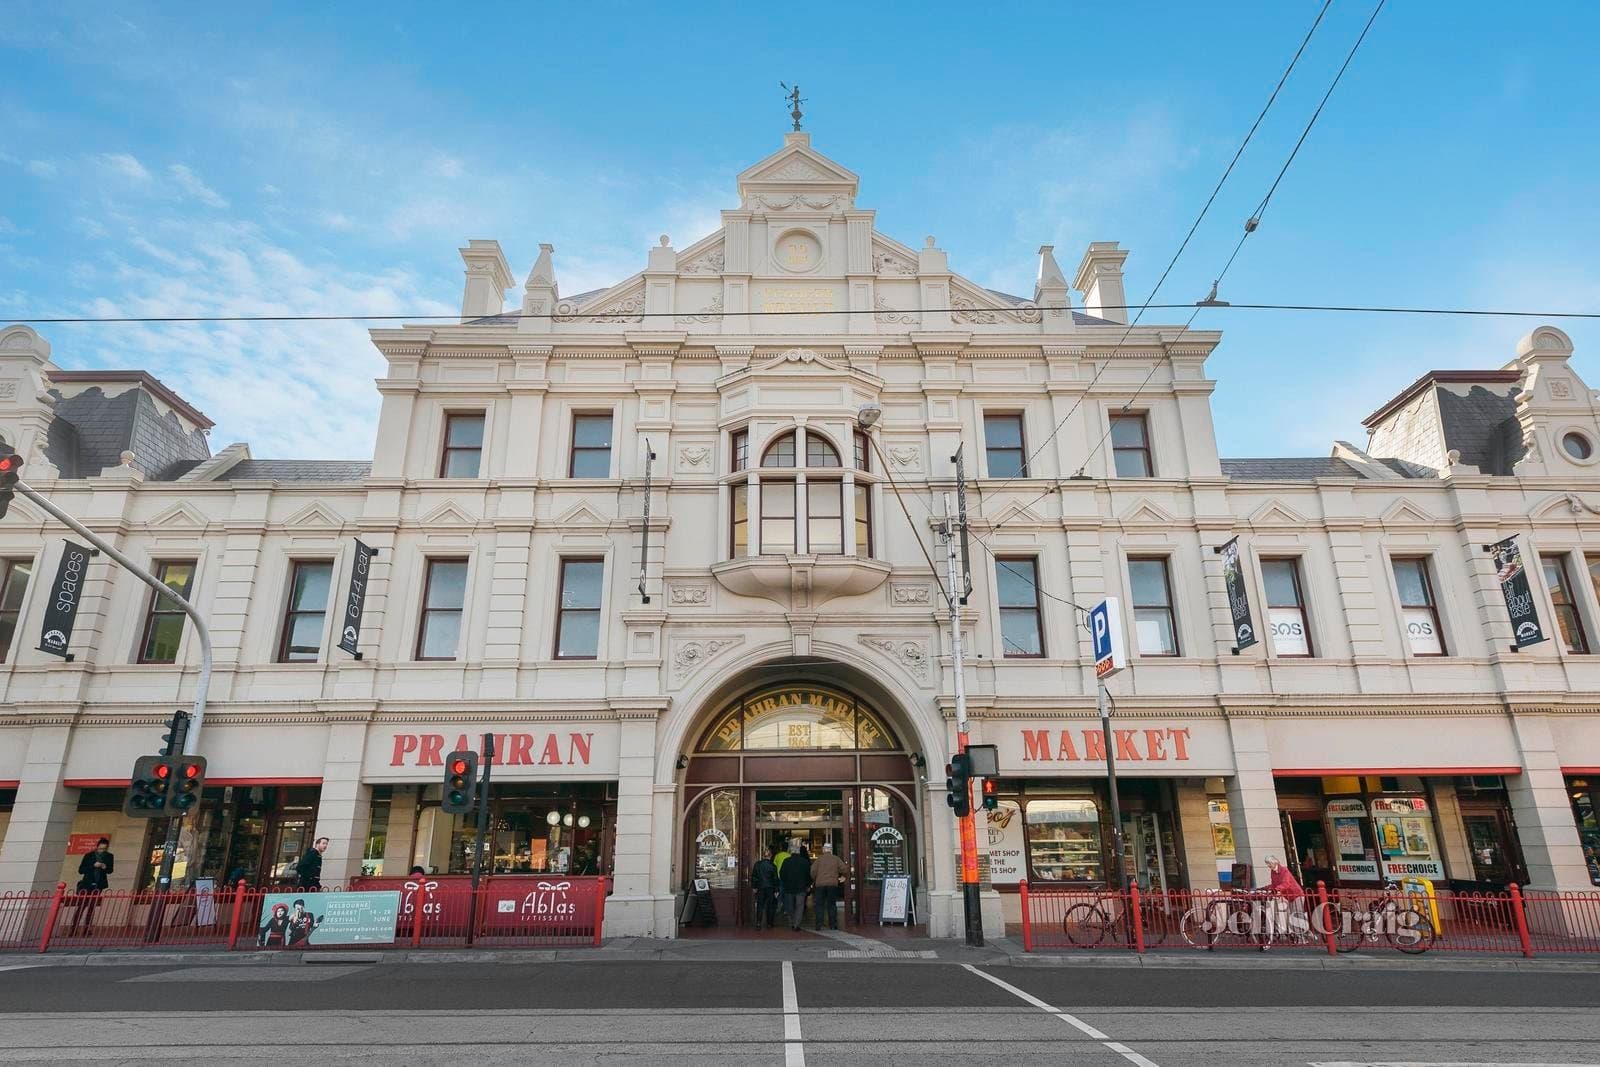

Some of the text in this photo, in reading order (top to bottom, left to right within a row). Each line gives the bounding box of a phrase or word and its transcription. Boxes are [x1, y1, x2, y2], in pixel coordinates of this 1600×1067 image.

[56, 551, 84, 613] spaces
[348, 579, 364, 618] 644
[357, 547, 369, 575] car
[1094, 611, 1106, 654] P
[717, 693, 802, 743] PRAHRAN
[788, 724, 811, 737] EST
[390, 733, 593, 766] PRAHRAN
[788, 737, 811, 750] 1864
[1020, 727, 1191, 761] MARKET
[1339, 865, 1375, 873] FREECHOICE
[1387, 863, 1439, 874] FREECHOICE
